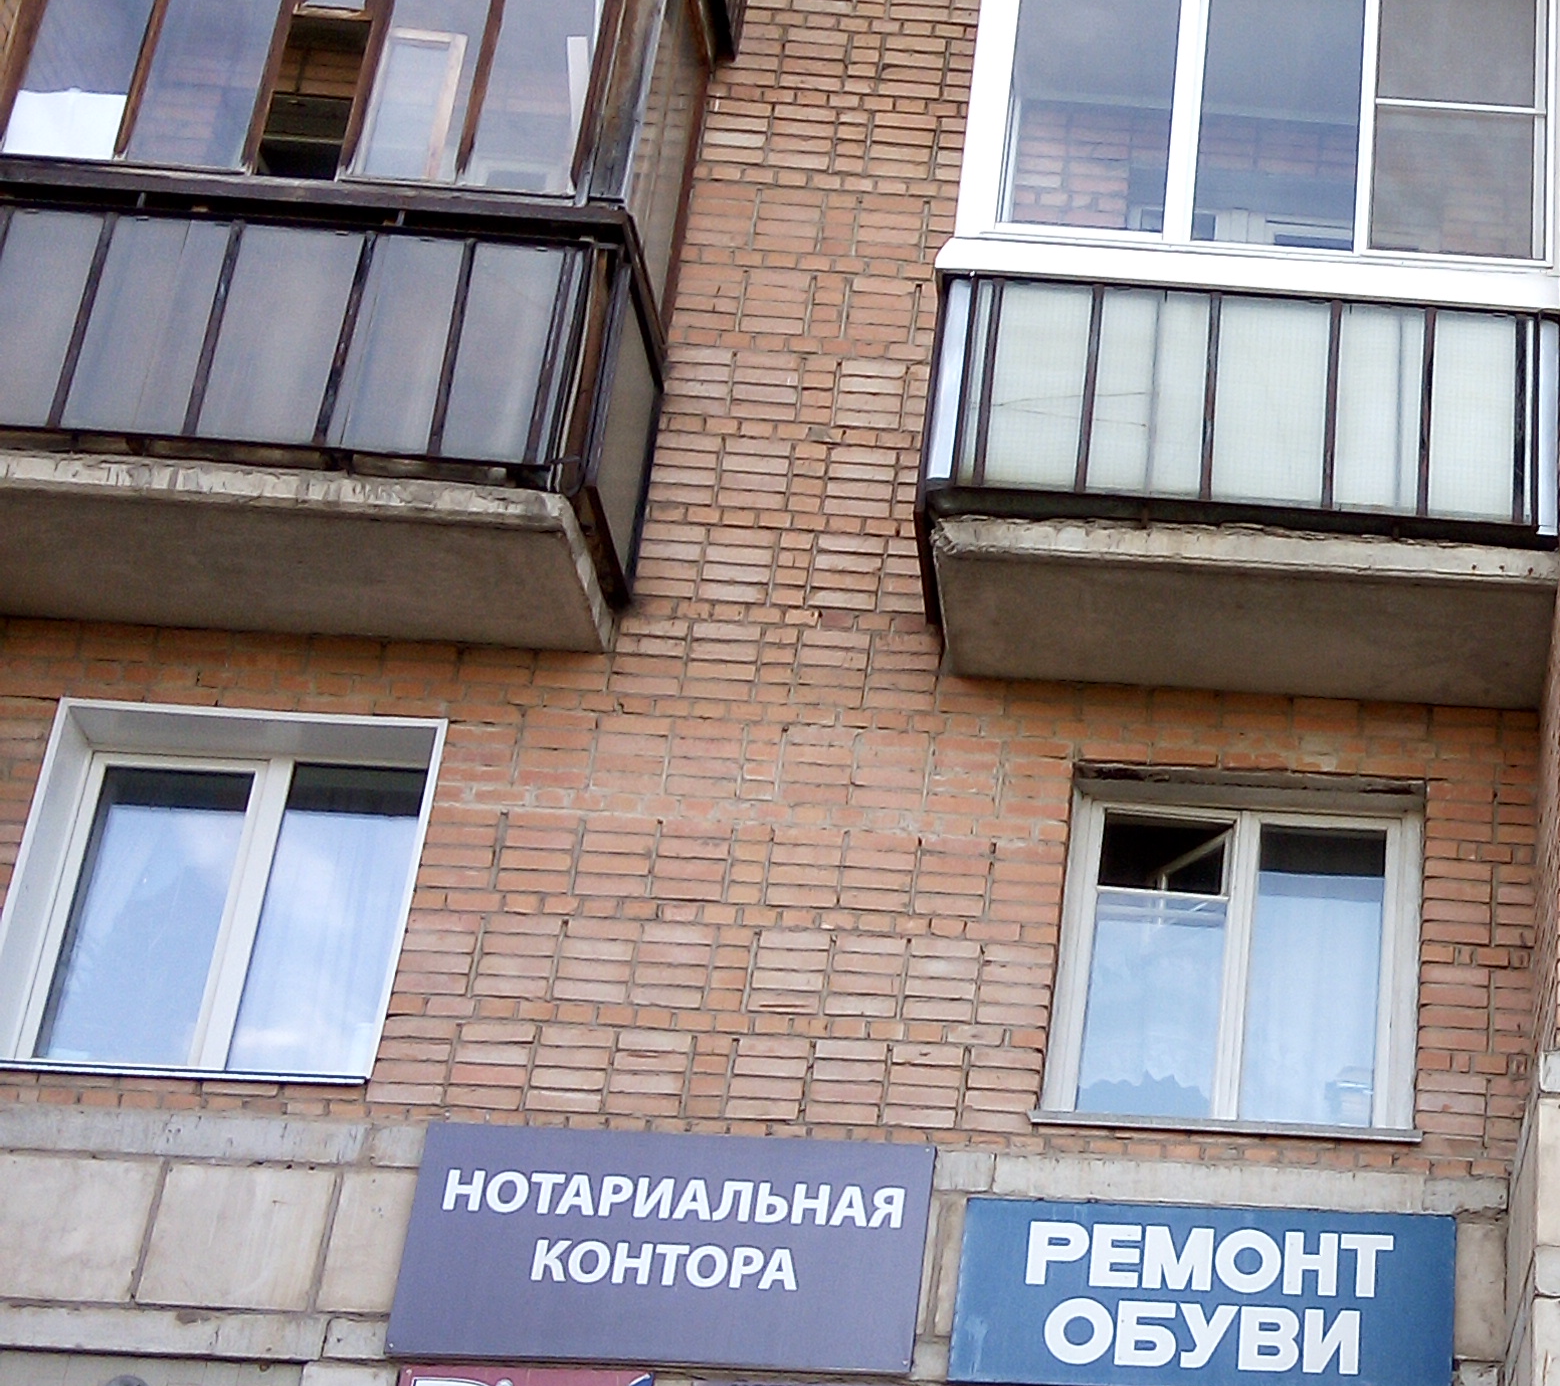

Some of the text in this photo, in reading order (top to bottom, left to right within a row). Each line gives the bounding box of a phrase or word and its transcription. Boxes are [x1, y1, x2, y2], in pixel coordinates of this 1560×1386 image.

[441, 1169, 906, 1230] НОТАРИАЛЬНАЯ
[530, 1239, 800, 1293] КОНТОРА
[1024, 1220, 1394, 1298] РЕМОНТ
[1043, 1297, 1361, 1376] ОБУВИ
